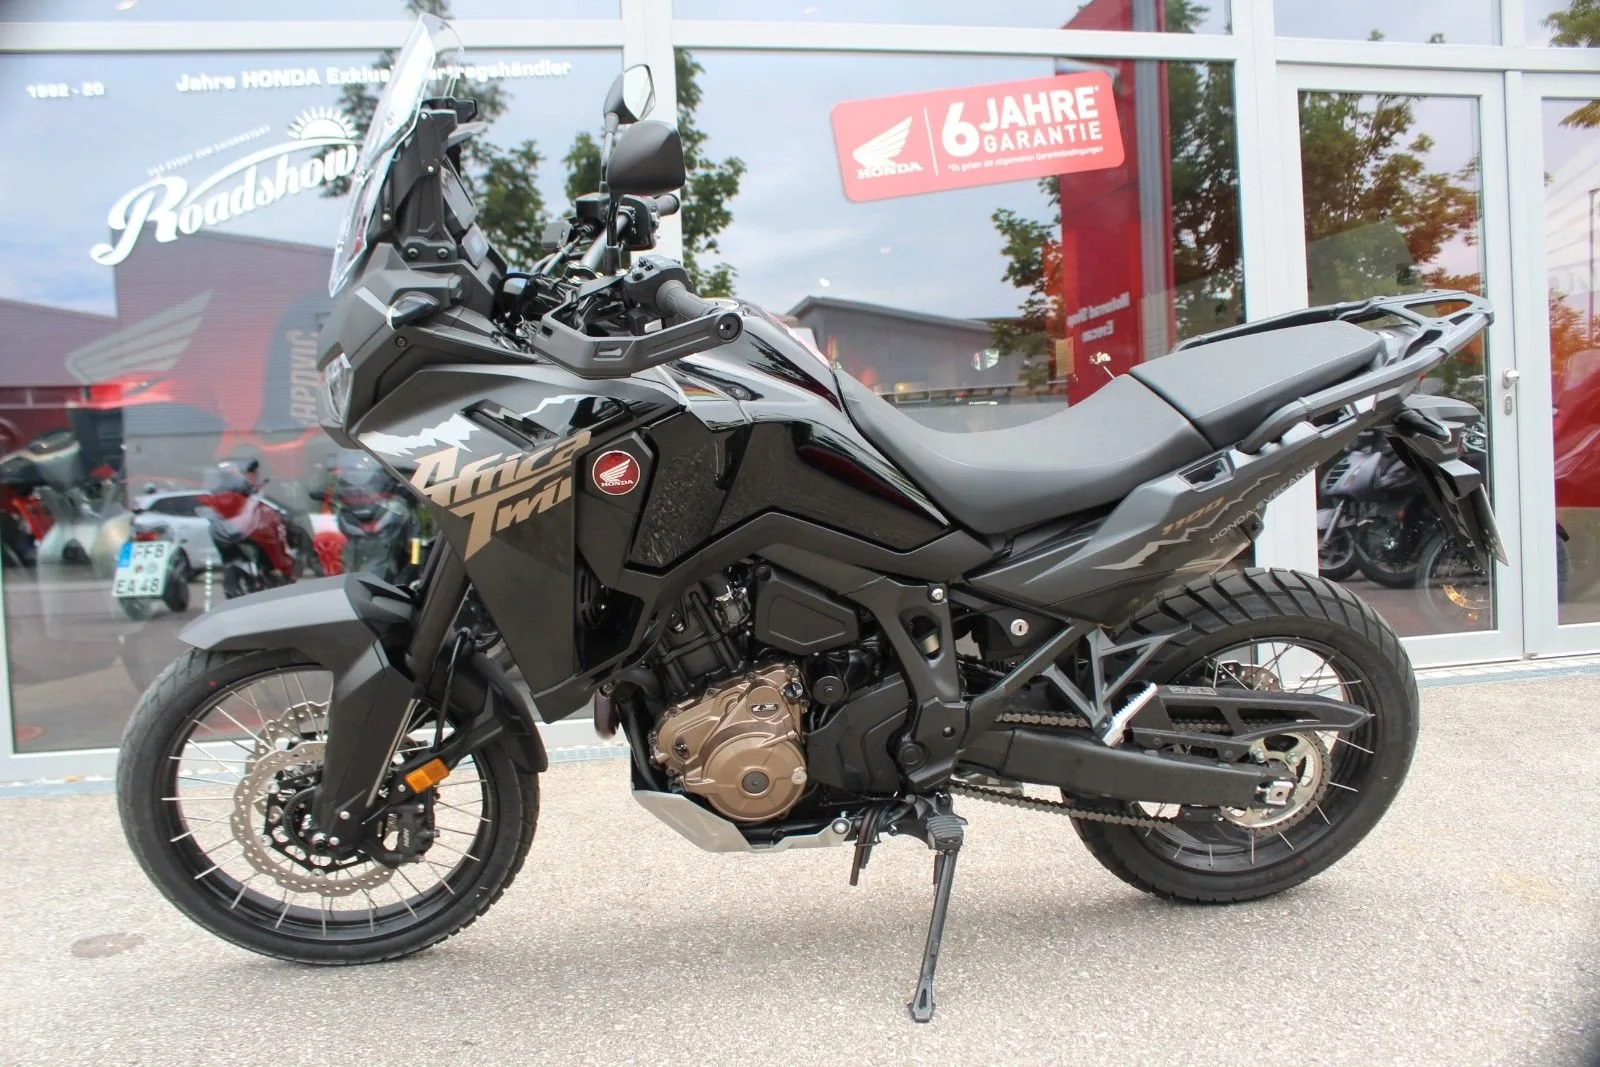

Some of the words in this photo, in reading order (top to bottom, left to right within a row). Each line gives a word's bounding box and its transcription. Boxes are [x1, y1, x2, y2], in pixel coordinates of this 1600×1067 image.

[176, 73, 236, 92] Jahre
[242, 68, 321, 88] HONDA
[427, 58, 572, 82] ertragshändler
[942, 101, 980, 157] 6
[983, 120, 1102, 153] GARANTIE
[856, 162, 924, 181] HONDA
[90, 144, 359, 266] Roadshow
[601, 479, 635, 487] HONDA
